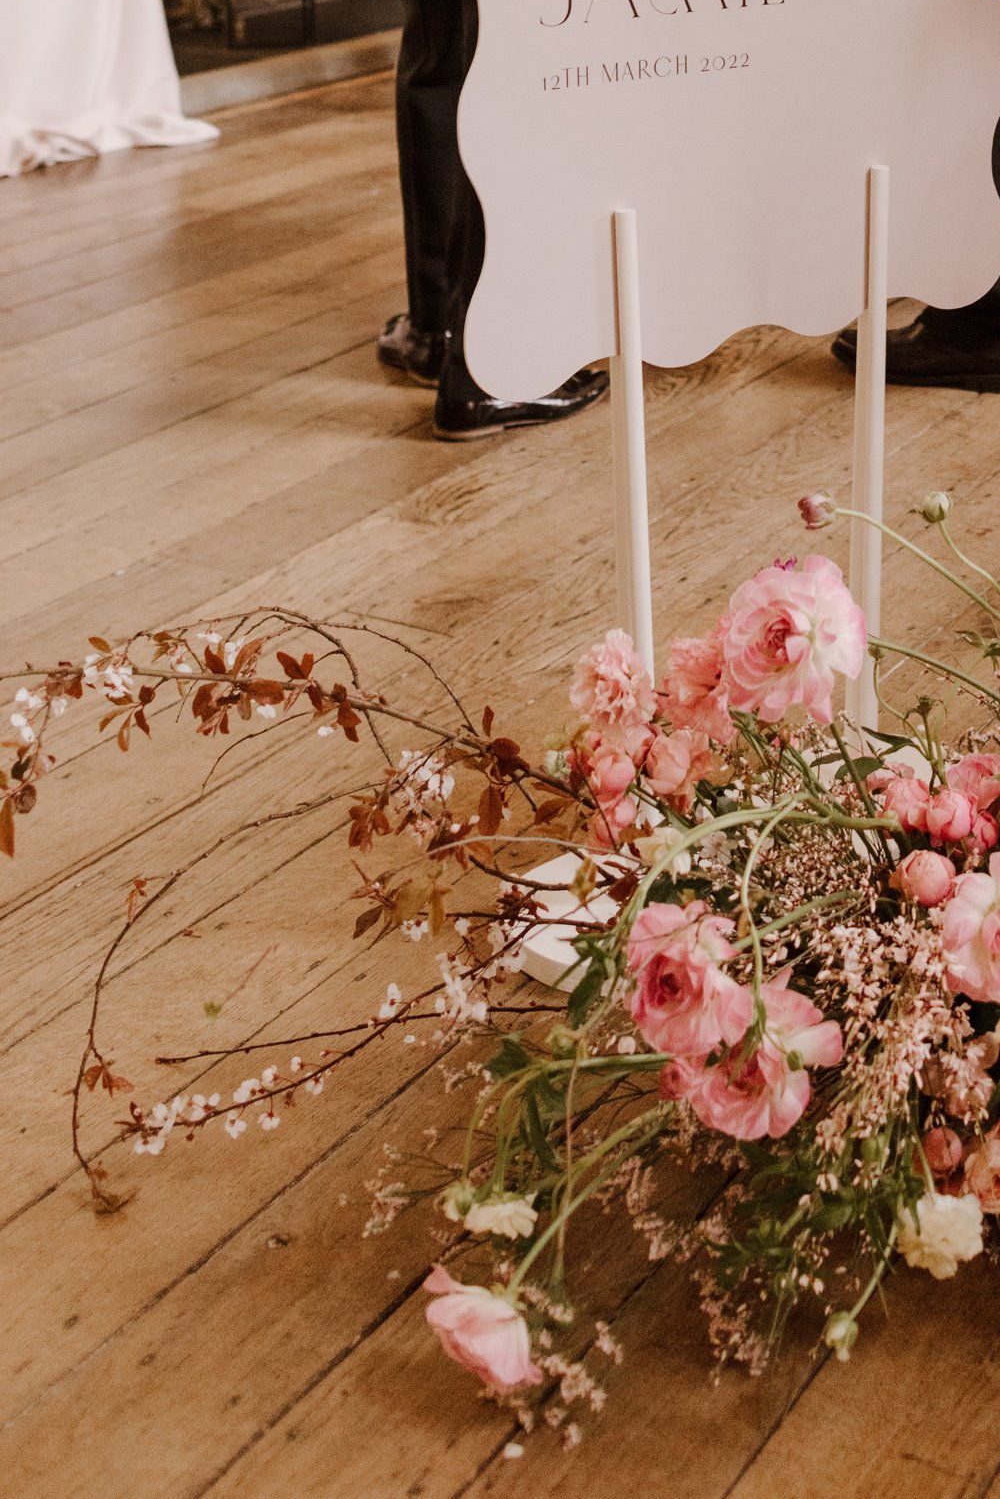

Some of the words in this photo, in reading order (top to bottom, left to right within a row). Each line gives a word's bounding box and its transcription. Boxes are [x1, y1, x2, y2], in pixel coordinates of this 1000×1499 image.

[542, 66, 590, 92] 12TH
[601, 55, 689, 84] MARCH
[700, 52, 750, 73] 2022
